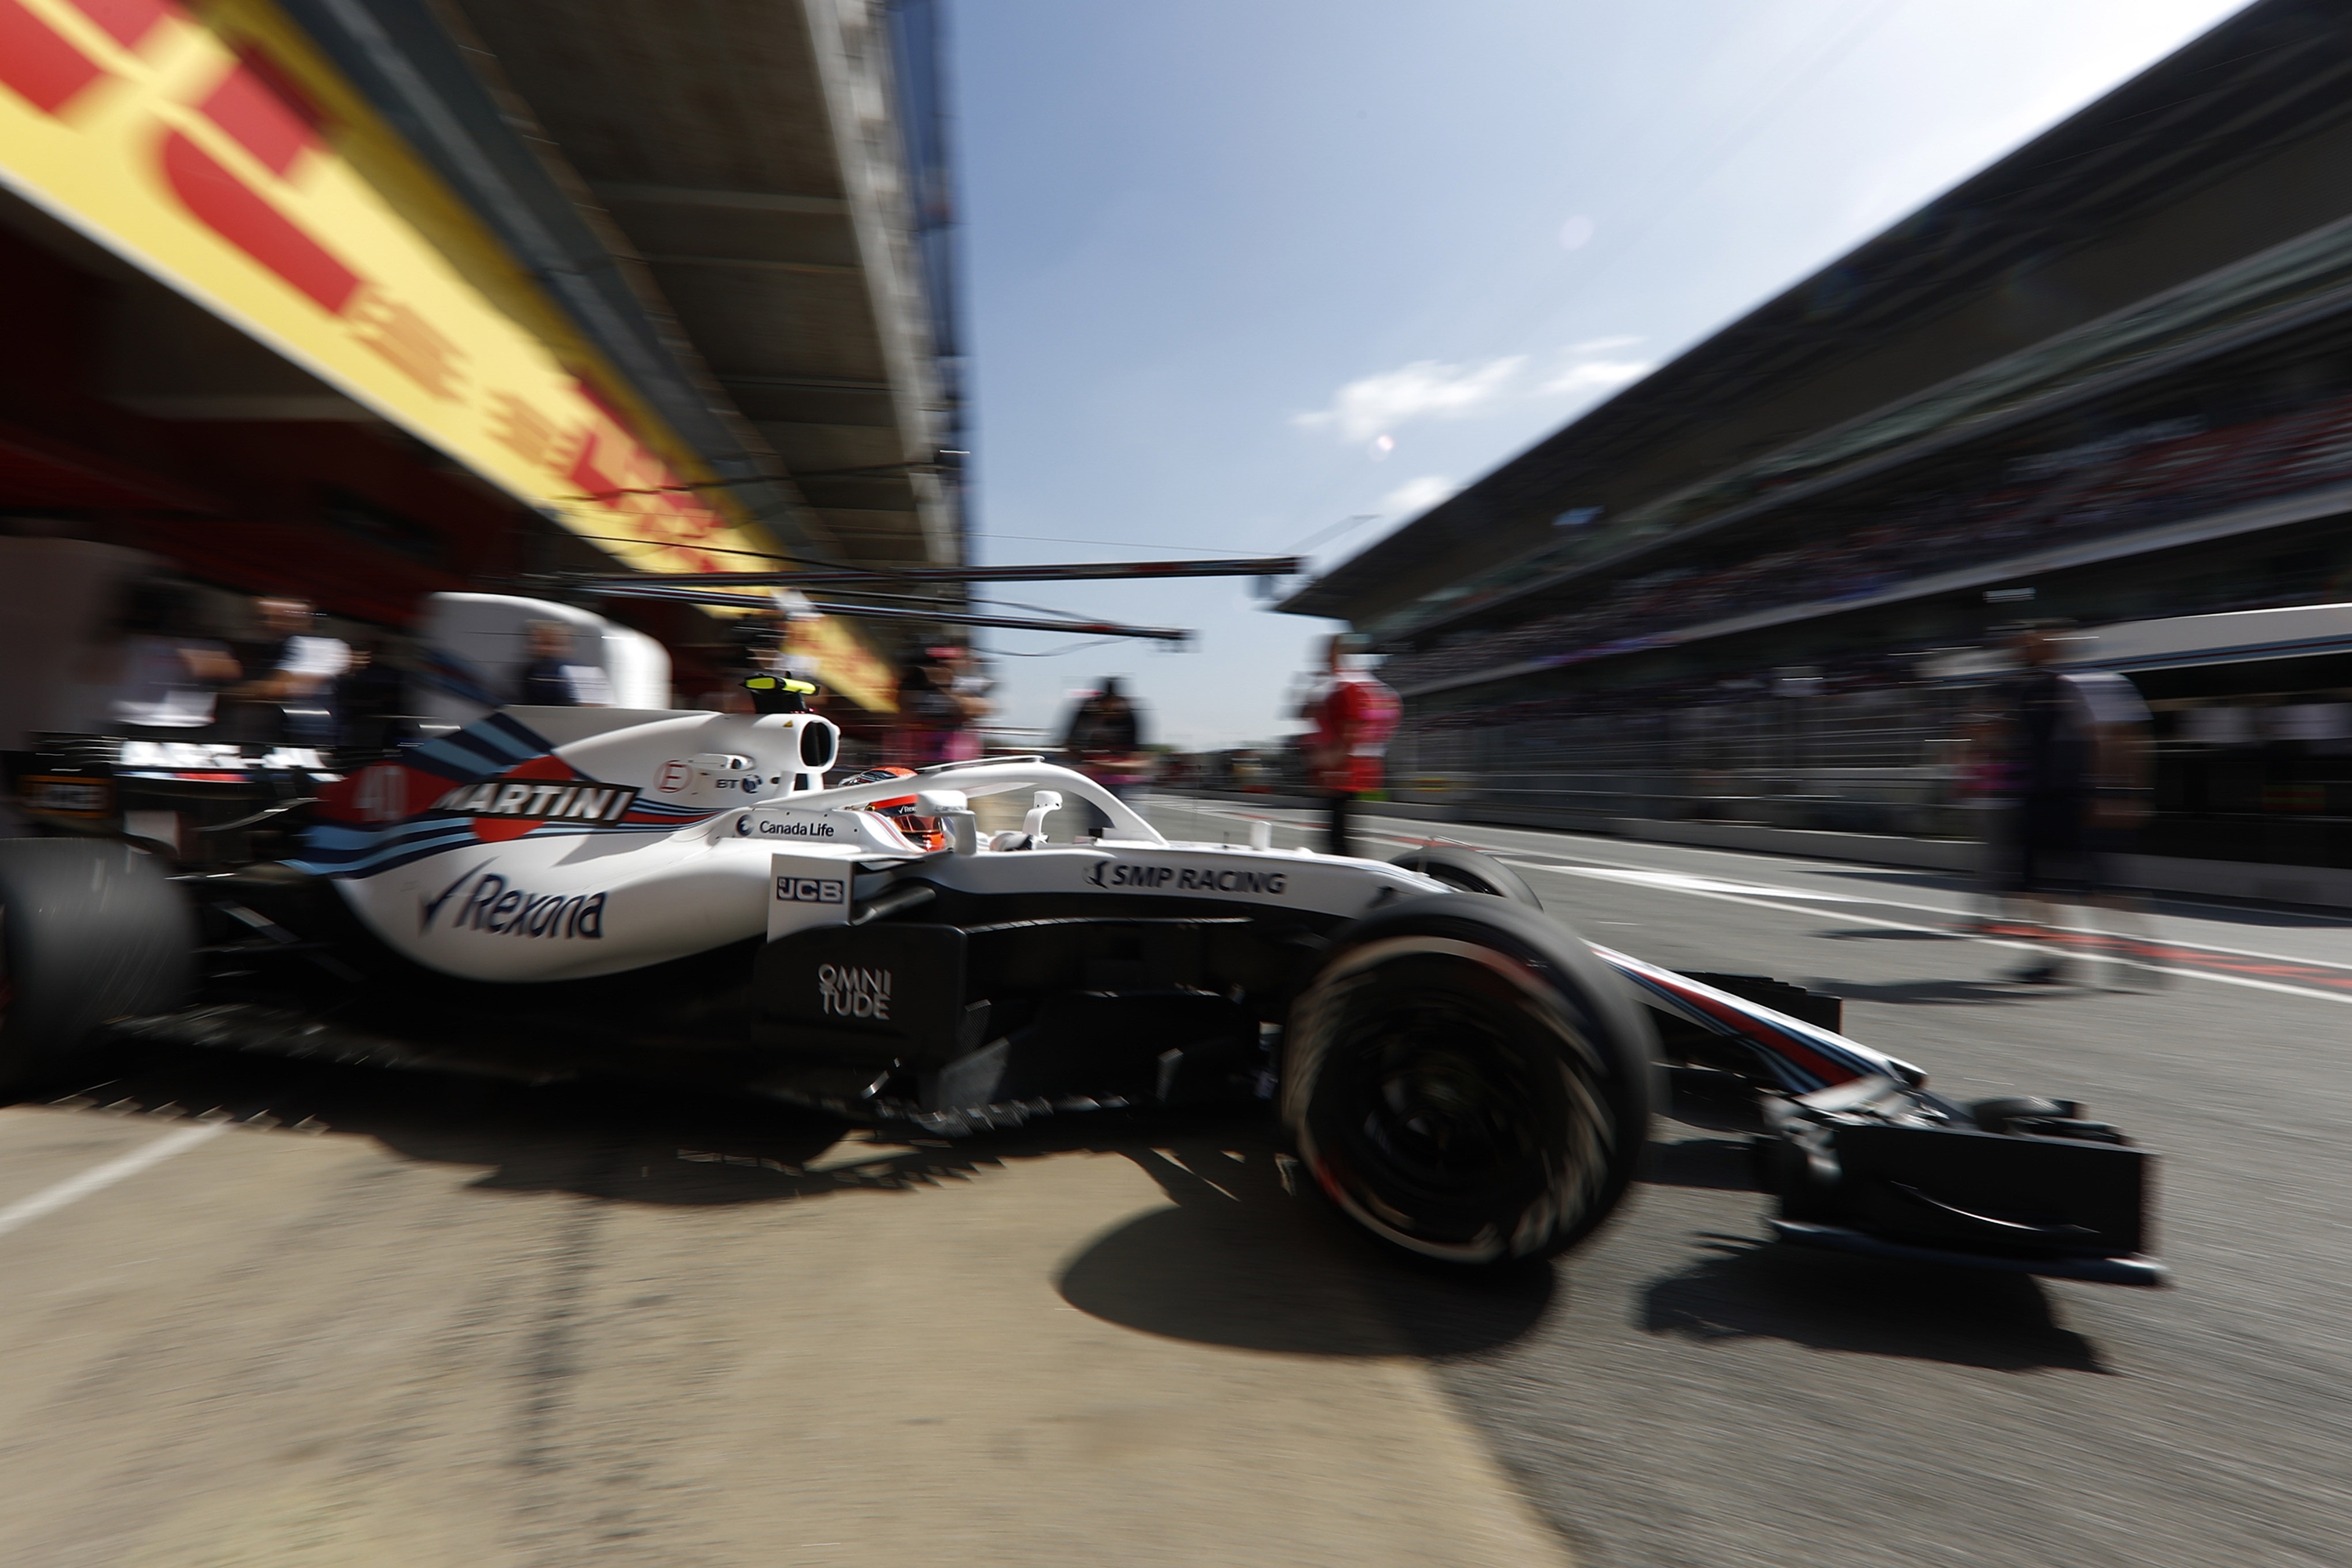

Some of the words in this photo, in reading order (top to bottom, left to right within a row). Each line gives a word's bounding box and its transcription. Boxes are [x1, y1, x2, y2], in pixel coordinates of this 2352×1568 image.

[715, 779, 739, 789] BT
[429, 782, 635, 821] MARTINI
[759, 820, 808, 836] Canada
[810, 822, 834, 837] Life
[778, 877, 843, 902] JCB
[1111, 865, 1174, 887] SMP
[1177, 868, 1287, 895] RACING
[452, 873, 608, 939] Rexona
[818, 964, 891, 996] OMNI
[819, 982, 891, 1020] TUDE
